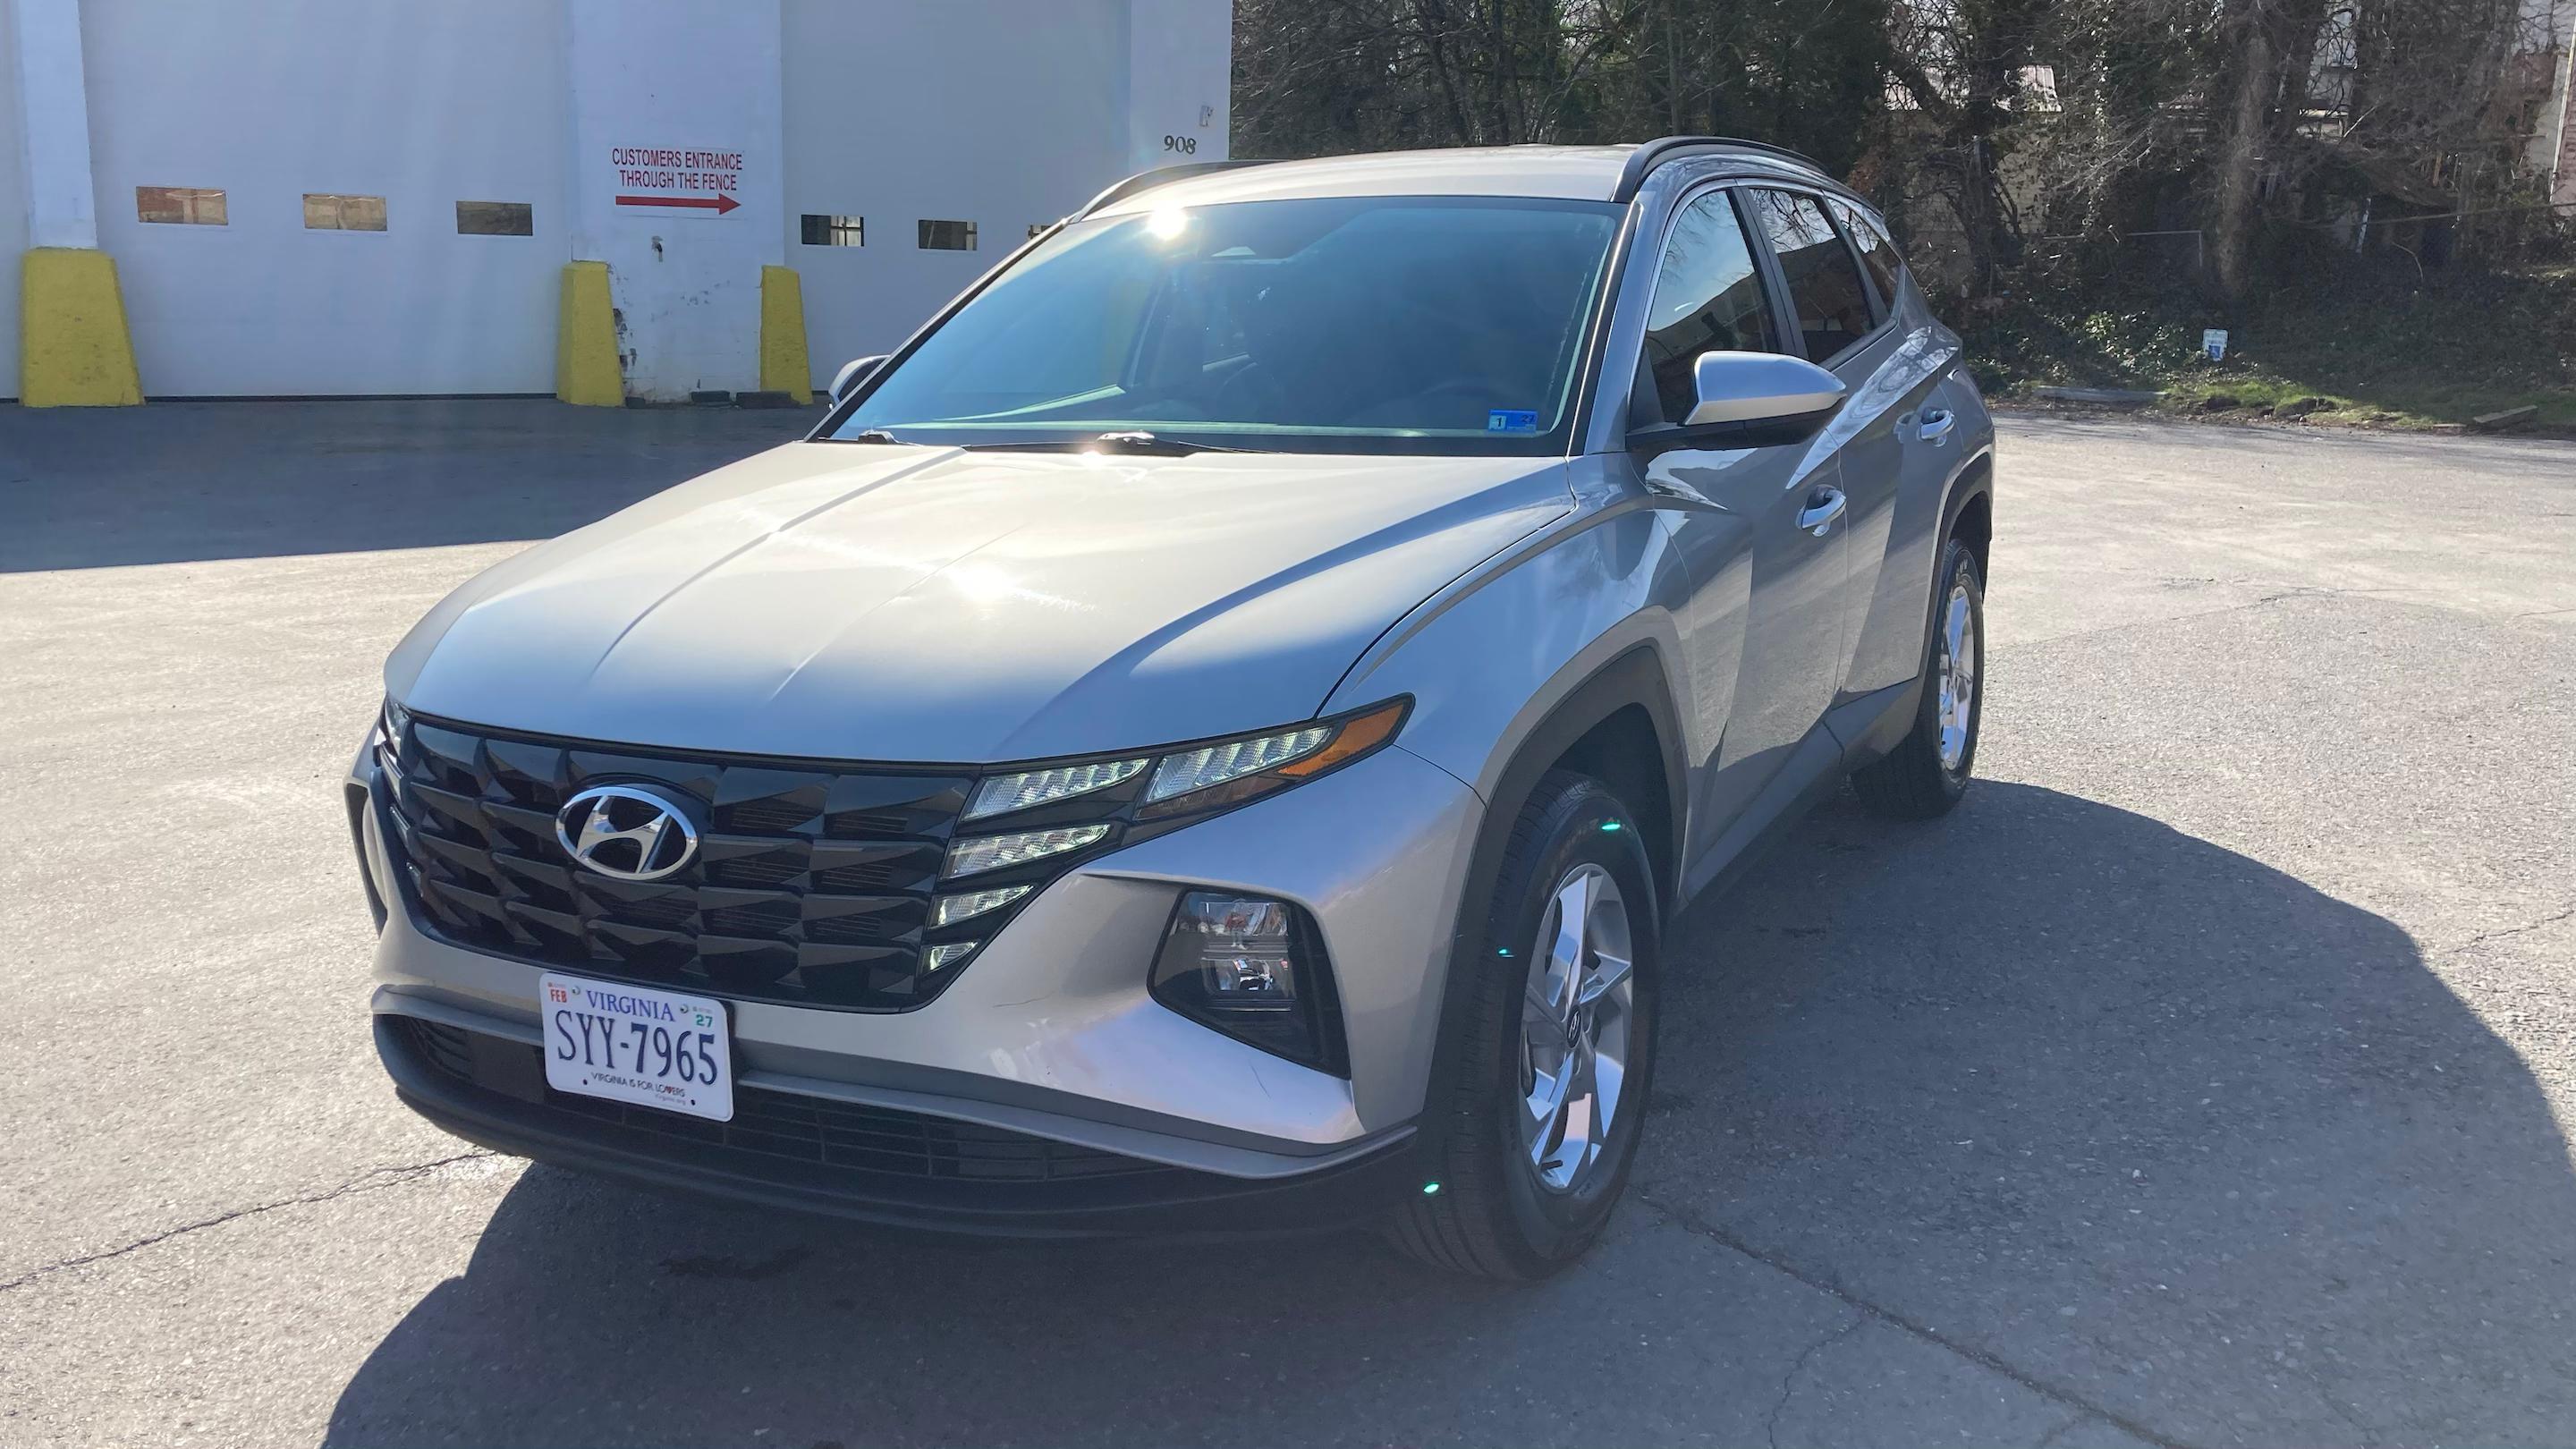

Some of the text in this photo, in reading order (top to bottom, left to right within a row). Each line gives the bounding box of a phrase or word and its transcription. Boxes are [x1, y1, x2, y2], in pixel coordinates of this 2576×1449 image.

[1164, 135, 1197, 155] 908
[613, 148, 742, 170] CUSTOMERS ENTRANCE
[619, 170, 737, 191] THROUGH THE FENCE
[550, 988, 567, 1003] FEB
[586, 989, 675, 1022] VIRGINIA
[696, 1014, 713, 1028] 27
[555, 1009, 717, 1086] SYY-7965
[591, 1072, 627, 1087] VIRGINIA
[637, 1080, 654, 1091] FOR
